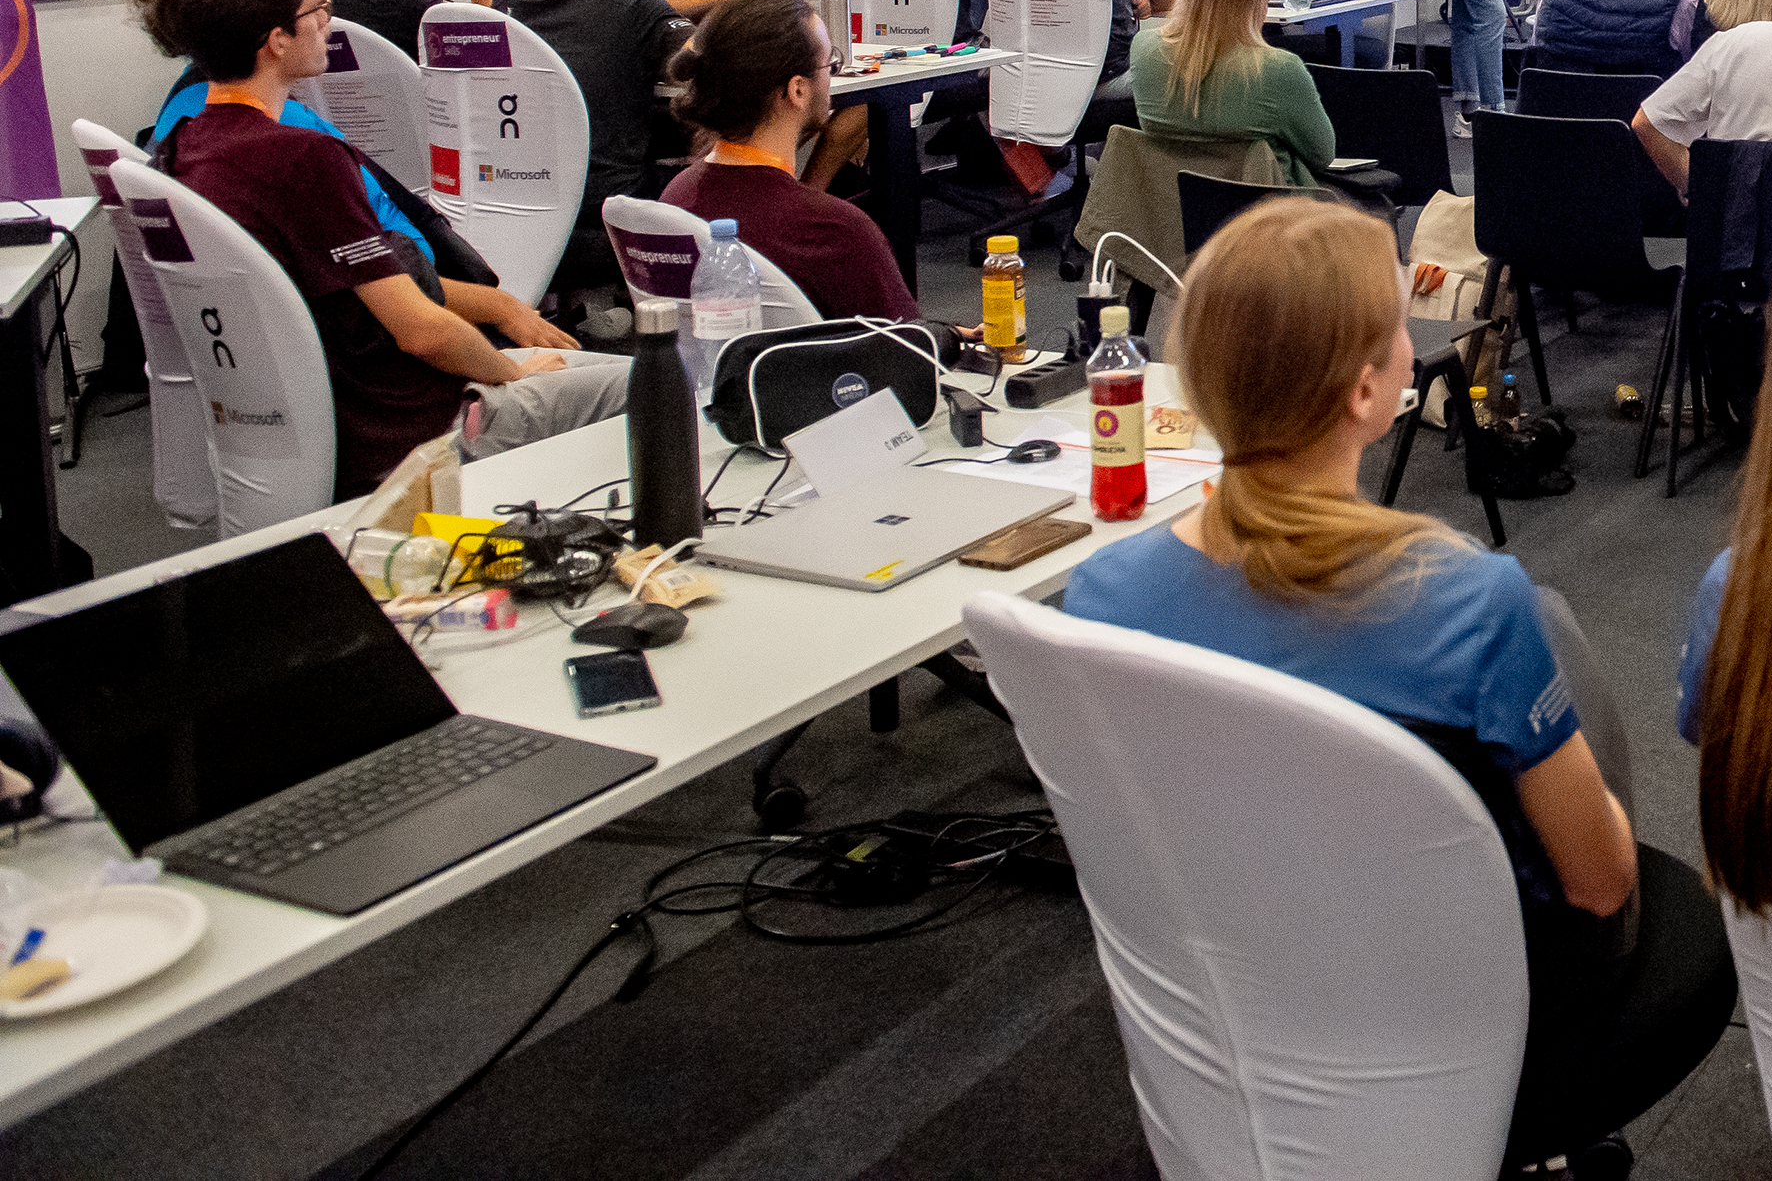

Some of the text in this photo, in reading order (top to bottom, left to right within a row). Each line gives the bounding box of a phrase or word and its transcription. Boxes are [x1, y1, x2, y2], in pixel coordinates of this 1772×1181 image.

[889, 24, 931, 35] Microsoft
[443, 34, 500, 45] entrepreneur
[495, 169, 551, 180] Microsoft
[891, 429, 914, 450] TEAM
